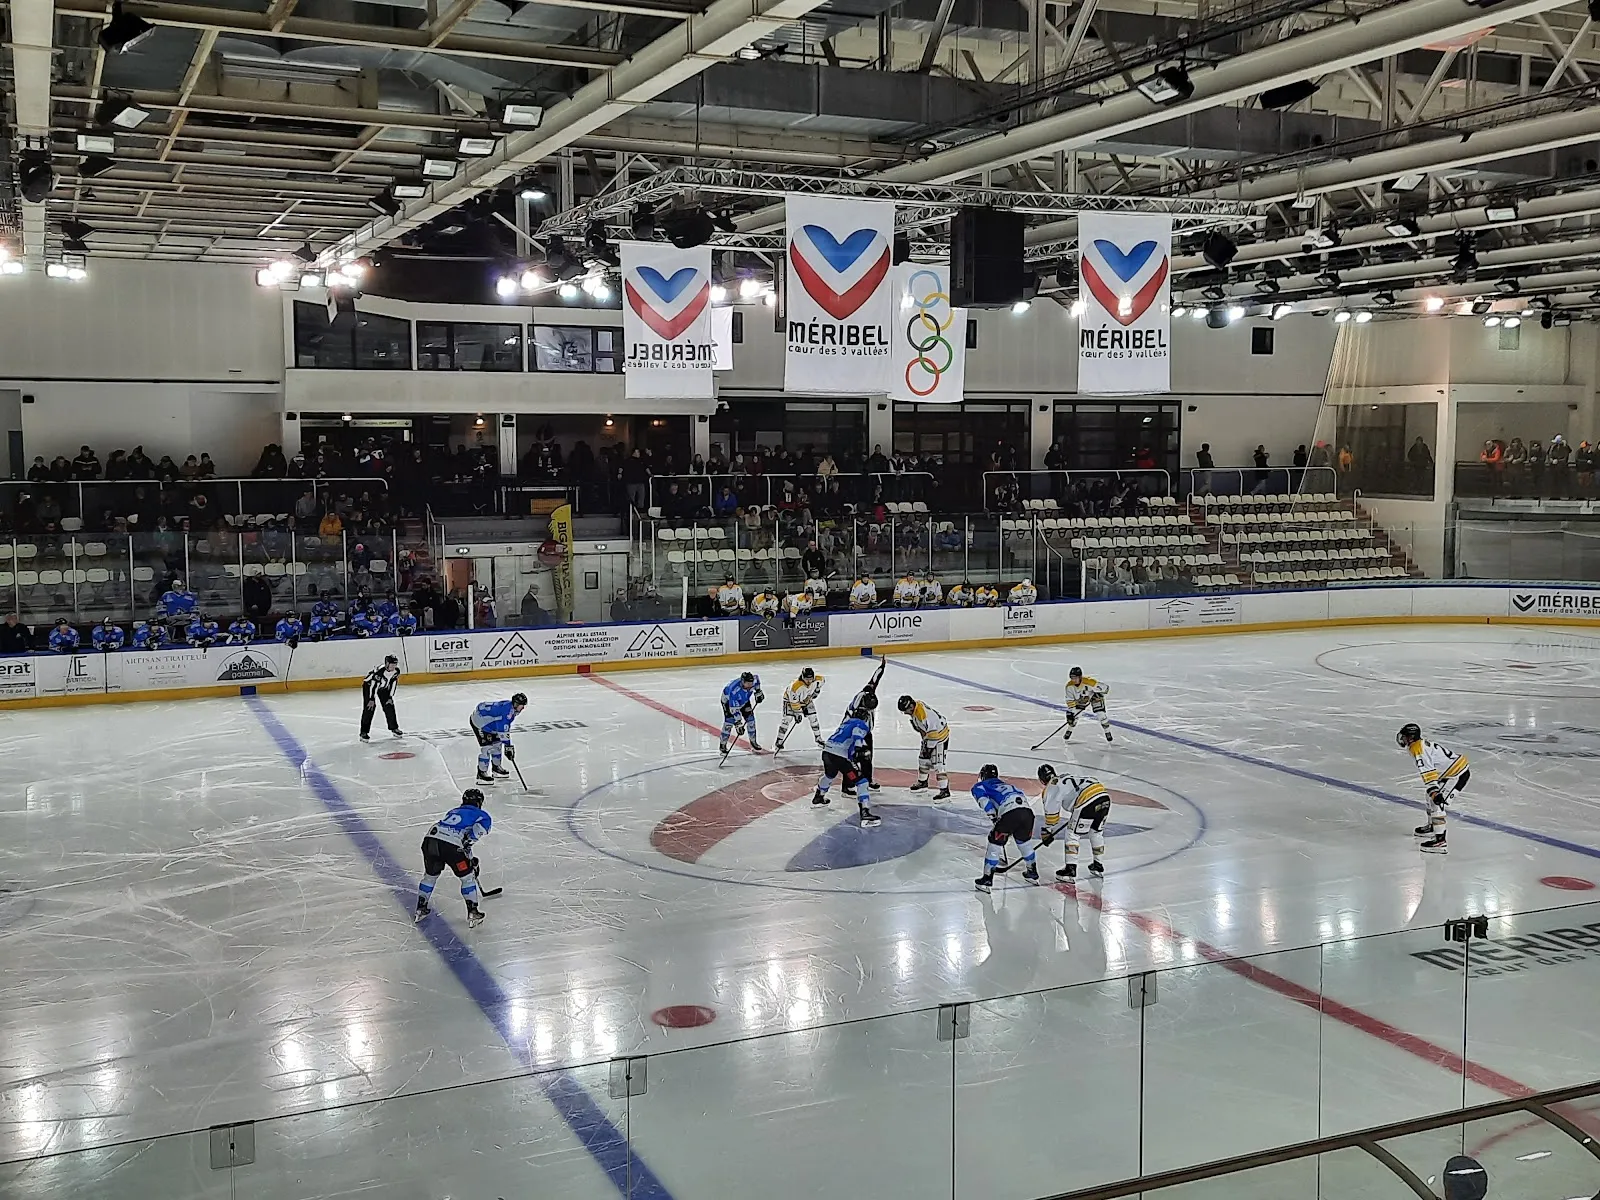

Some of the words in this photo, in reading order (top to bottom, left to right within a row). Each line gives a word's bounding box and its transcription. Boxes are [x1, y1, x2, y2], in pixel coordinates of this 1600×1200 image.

[789, 317, 889, 346] MÉRIBEL
[1080, 318, 1167, 349] MÉRIBEL
[788, 345, 815, 354] cœur
[819, 346, 837, 355] des
[841, 346, 847, 355] 3
[851, 346, 888, 356] vallées
[1081, 350, 1104, 358] cœur
[1107, 350, 1124, 358] des
[1128, 350, 1133, 358] 3
[1136, 349, 1167, 358] vallées
[1007, 609, 1034, 620] Lerat
[795, 617, 825, 632] Refuge
[868, 612, 922, 634] Alpine
[689, 625, 720, 637] Lerat
[434, 638, 470, 651] Lerat
[126, 656, 162, 665] ARTISAN
[164, 653, 208, 663] TRAITEUR
[223, 660, 269, 671] VERSANT
[1536, 954, 1587, 966] des
